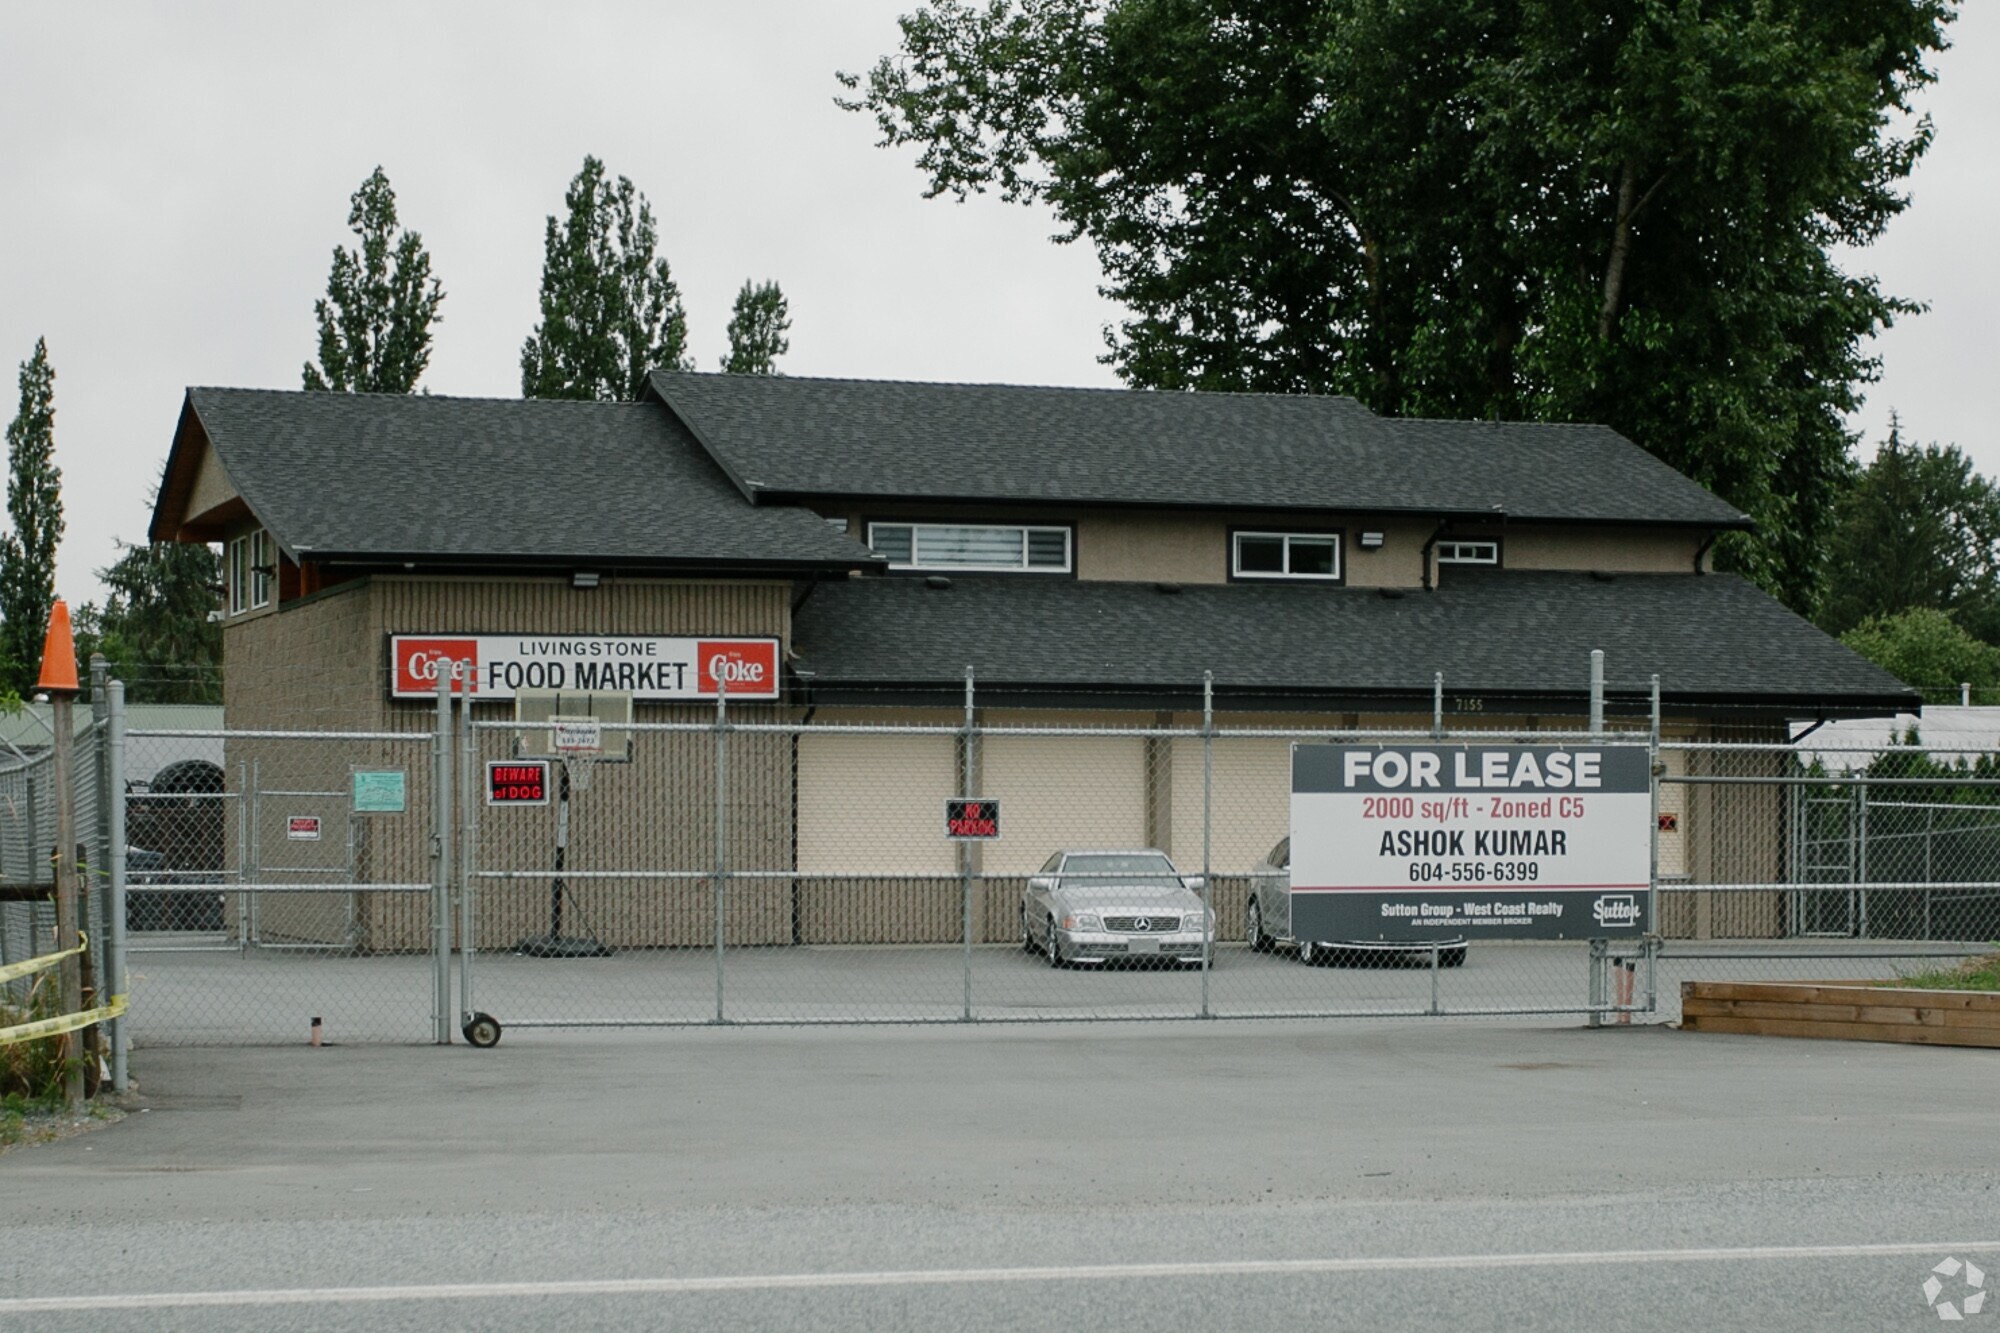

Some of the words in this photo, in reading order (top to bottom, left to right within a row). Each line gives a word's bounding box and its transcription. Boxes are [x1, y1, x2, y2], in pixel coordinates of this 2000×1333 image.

[520, 641, 657, 656] LIVINGSTONE
[408, 652, 465, 680] Coe
[489, 661, 566, 690] FOOD
[575, 661, 689, 690] MARKET
[709, 653, 764, 682] Coke
[1455, 698, 1483, 711] 7155
[494, 767, 541, 781] BEWARE
[1343, 751, 1441, 788] FOR
[1454, 752, 1602, 788] LEASE
[493, 787, 506, 799] of
[509, 786, 541, 799] DOG
[964, 802, 980, 818] NO
[1362, 797, 1414, 819] 2000
[1420, 797, 1469, 823] sq/ft
[1490, 797, 1552, 818] Zoned
[1558, 797, 1585, 818] C5
[948, 819, 996, 836] PARKING
[1379, 830, 1465, 857] ASHOK
[1474, 830, 1567, 856] KUMAR
[1409, 862, 1539, 882] 604-556-6399
[1381, 903, 1419, 917] Sutton
[1420, 902, 1454, 918] Group
[1463, 902, 1492, 916] West
[1494, 902, 1525, 916] Coast
[1527, 902, 1563, 917] Realty
[1593, 899, 1641, 920] Sutton
